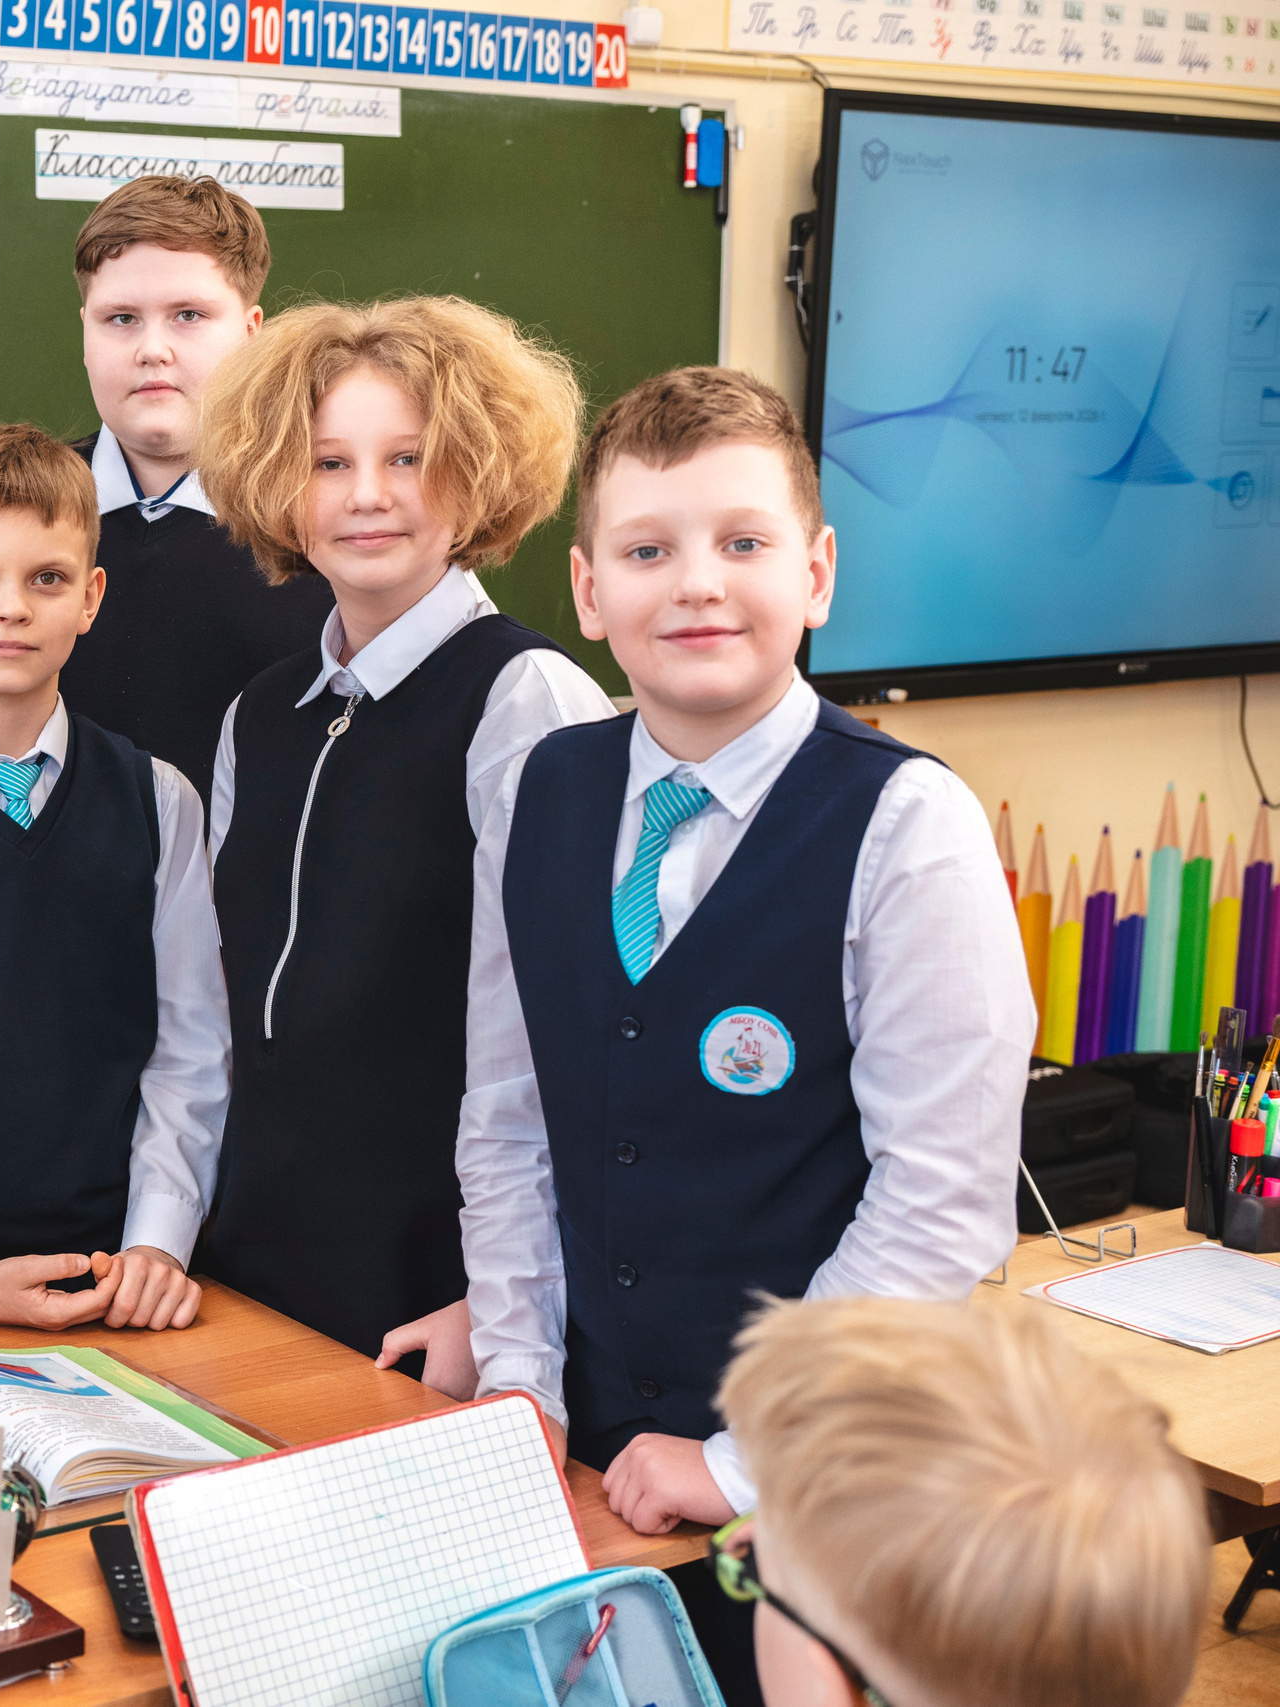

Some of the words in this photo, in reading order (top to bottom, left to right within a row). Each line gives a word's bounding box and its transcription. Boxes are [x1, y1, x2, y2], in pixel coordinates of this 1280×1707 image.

[6, 0, 27, 39] 3
[43, 0, 67, 41] 4
[80, 0, 102, 44] 5
[115, 0, 137, 46] 6
[149, 0, 170, 48] 7
[184, 0, 208, 51] 8
[220, 2, 241, 53] 9
[250, 6, 281, 56] 10
[287, 8, 315, 58] 11
[323, 11, 354, 61] 12
[360, 14, 390, 63] 13
[396, 17, 427, 66] 14
[432, 20, 464, 68] 15
[468, 23, 496, 71] 16
[500, 26, 529, 73] 17
[533, 28, 561, 76] 18
[564, 31, 592, 77] 19
[595, 33, 626, 79] 20
[40, 133, 204, 177] Классная
[757, 1020, 778, 1039] СОШ
